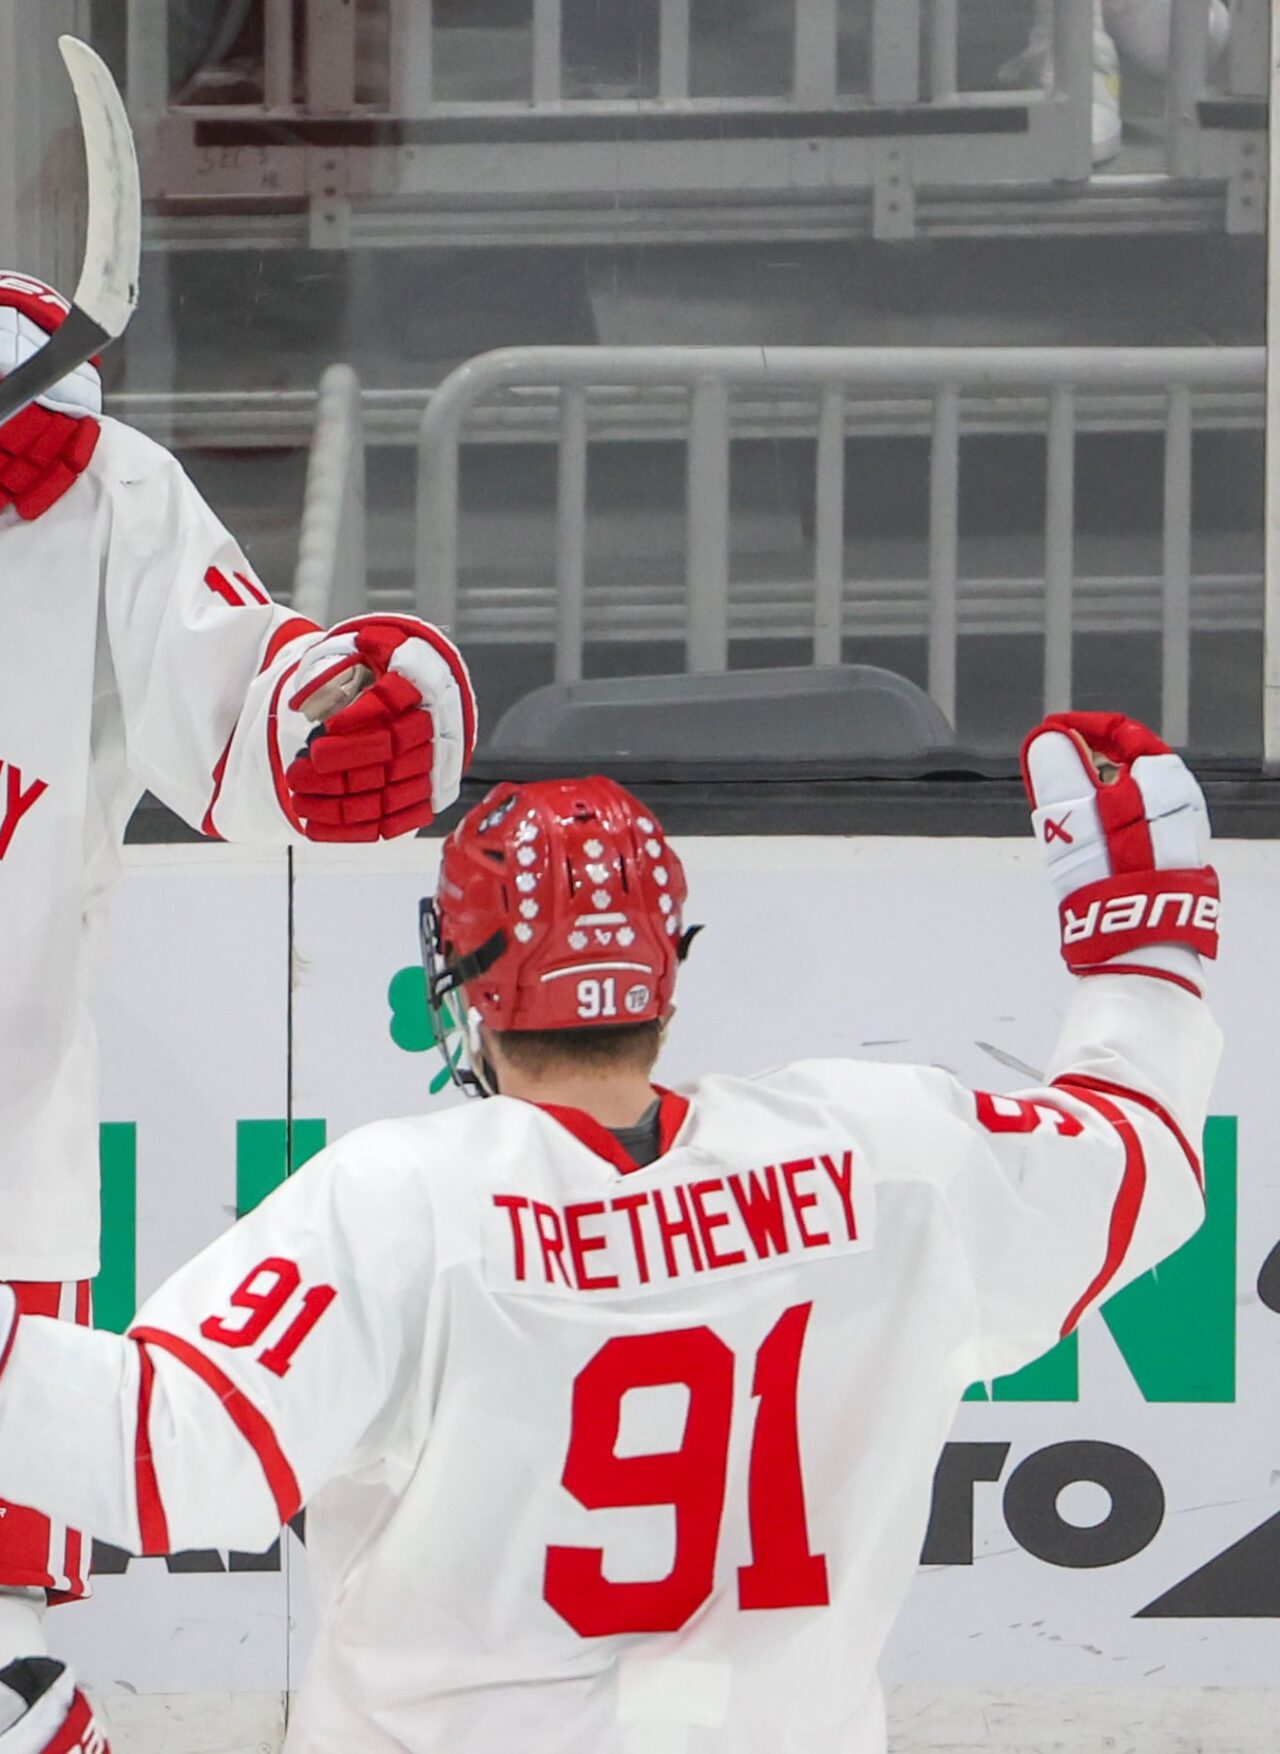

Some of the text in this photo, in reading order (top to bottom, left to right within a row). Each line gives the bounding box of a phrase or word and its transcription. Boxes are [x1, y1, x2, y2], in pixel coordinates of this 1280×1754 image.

[1064, 892, 1221, 945] AUER
[576, 978, 617, 1018] 91
[493, 1150, 858, 1292] TRETHEWEY
[199, 1256, 338, 1378] 91
[543, 1300, 831, 1639] 91
